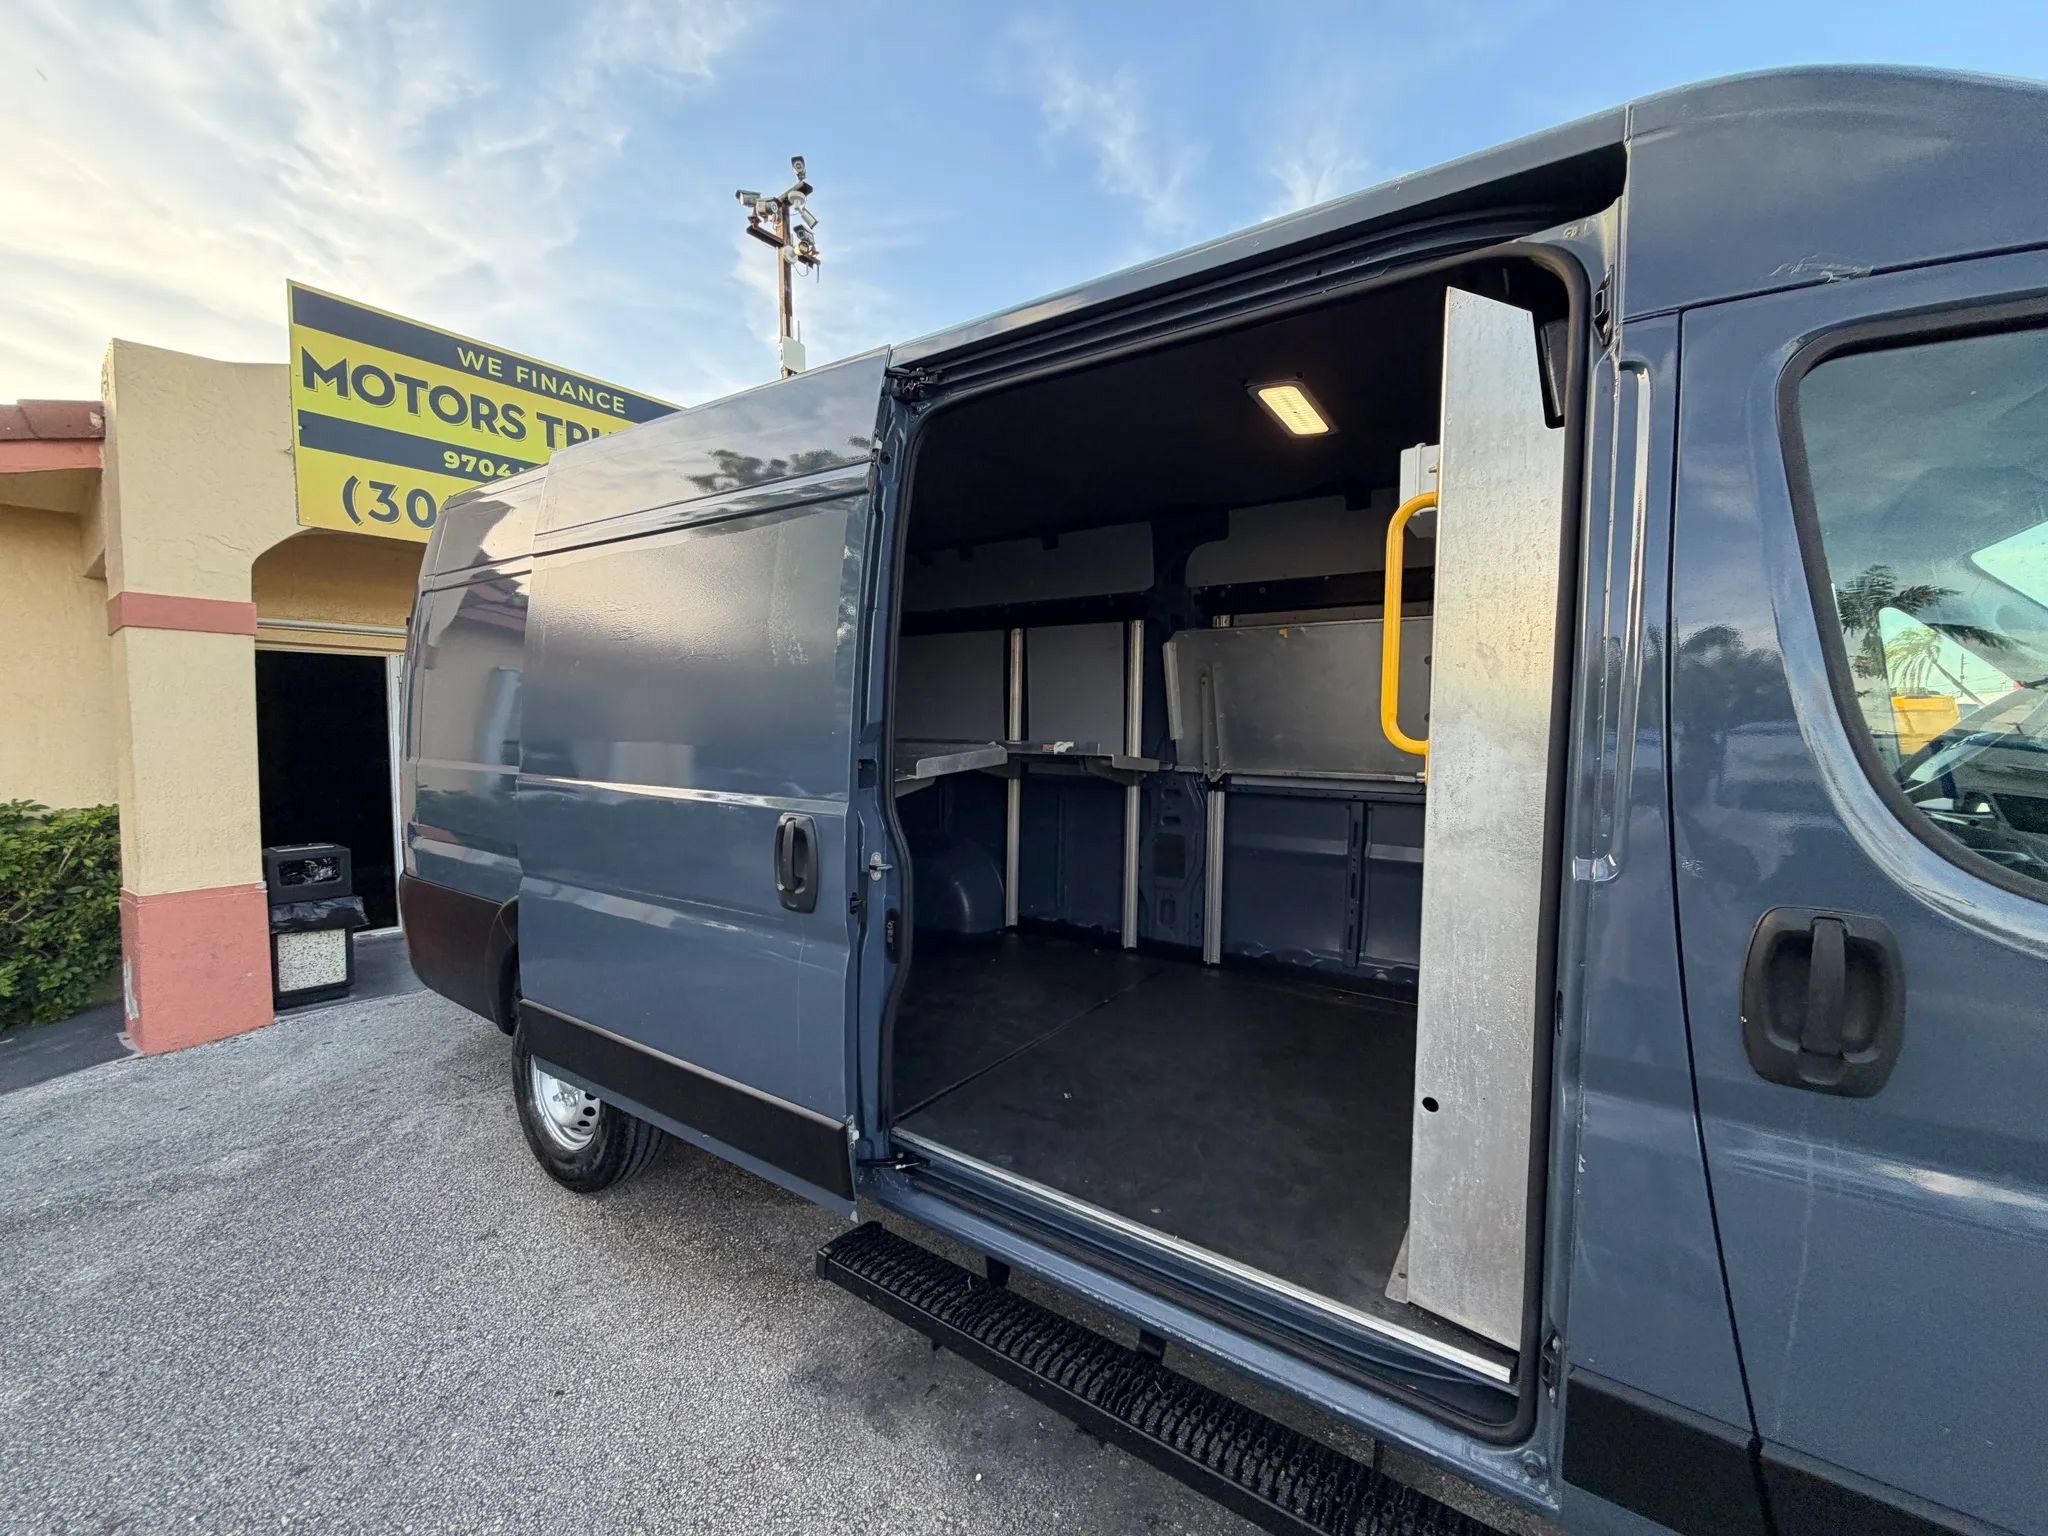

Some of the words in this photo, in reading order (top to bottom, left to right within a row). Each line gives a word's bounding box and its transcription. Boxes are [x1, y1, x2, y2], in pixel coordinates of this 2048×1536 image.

[301, 346, 528, 442] MOTORS
[536, 412, 600, 449] TR
[456, 347, 503, 377] WE
[517, 366, 626, 414] FINANCE
[443, 451, 512, 478] 9704
